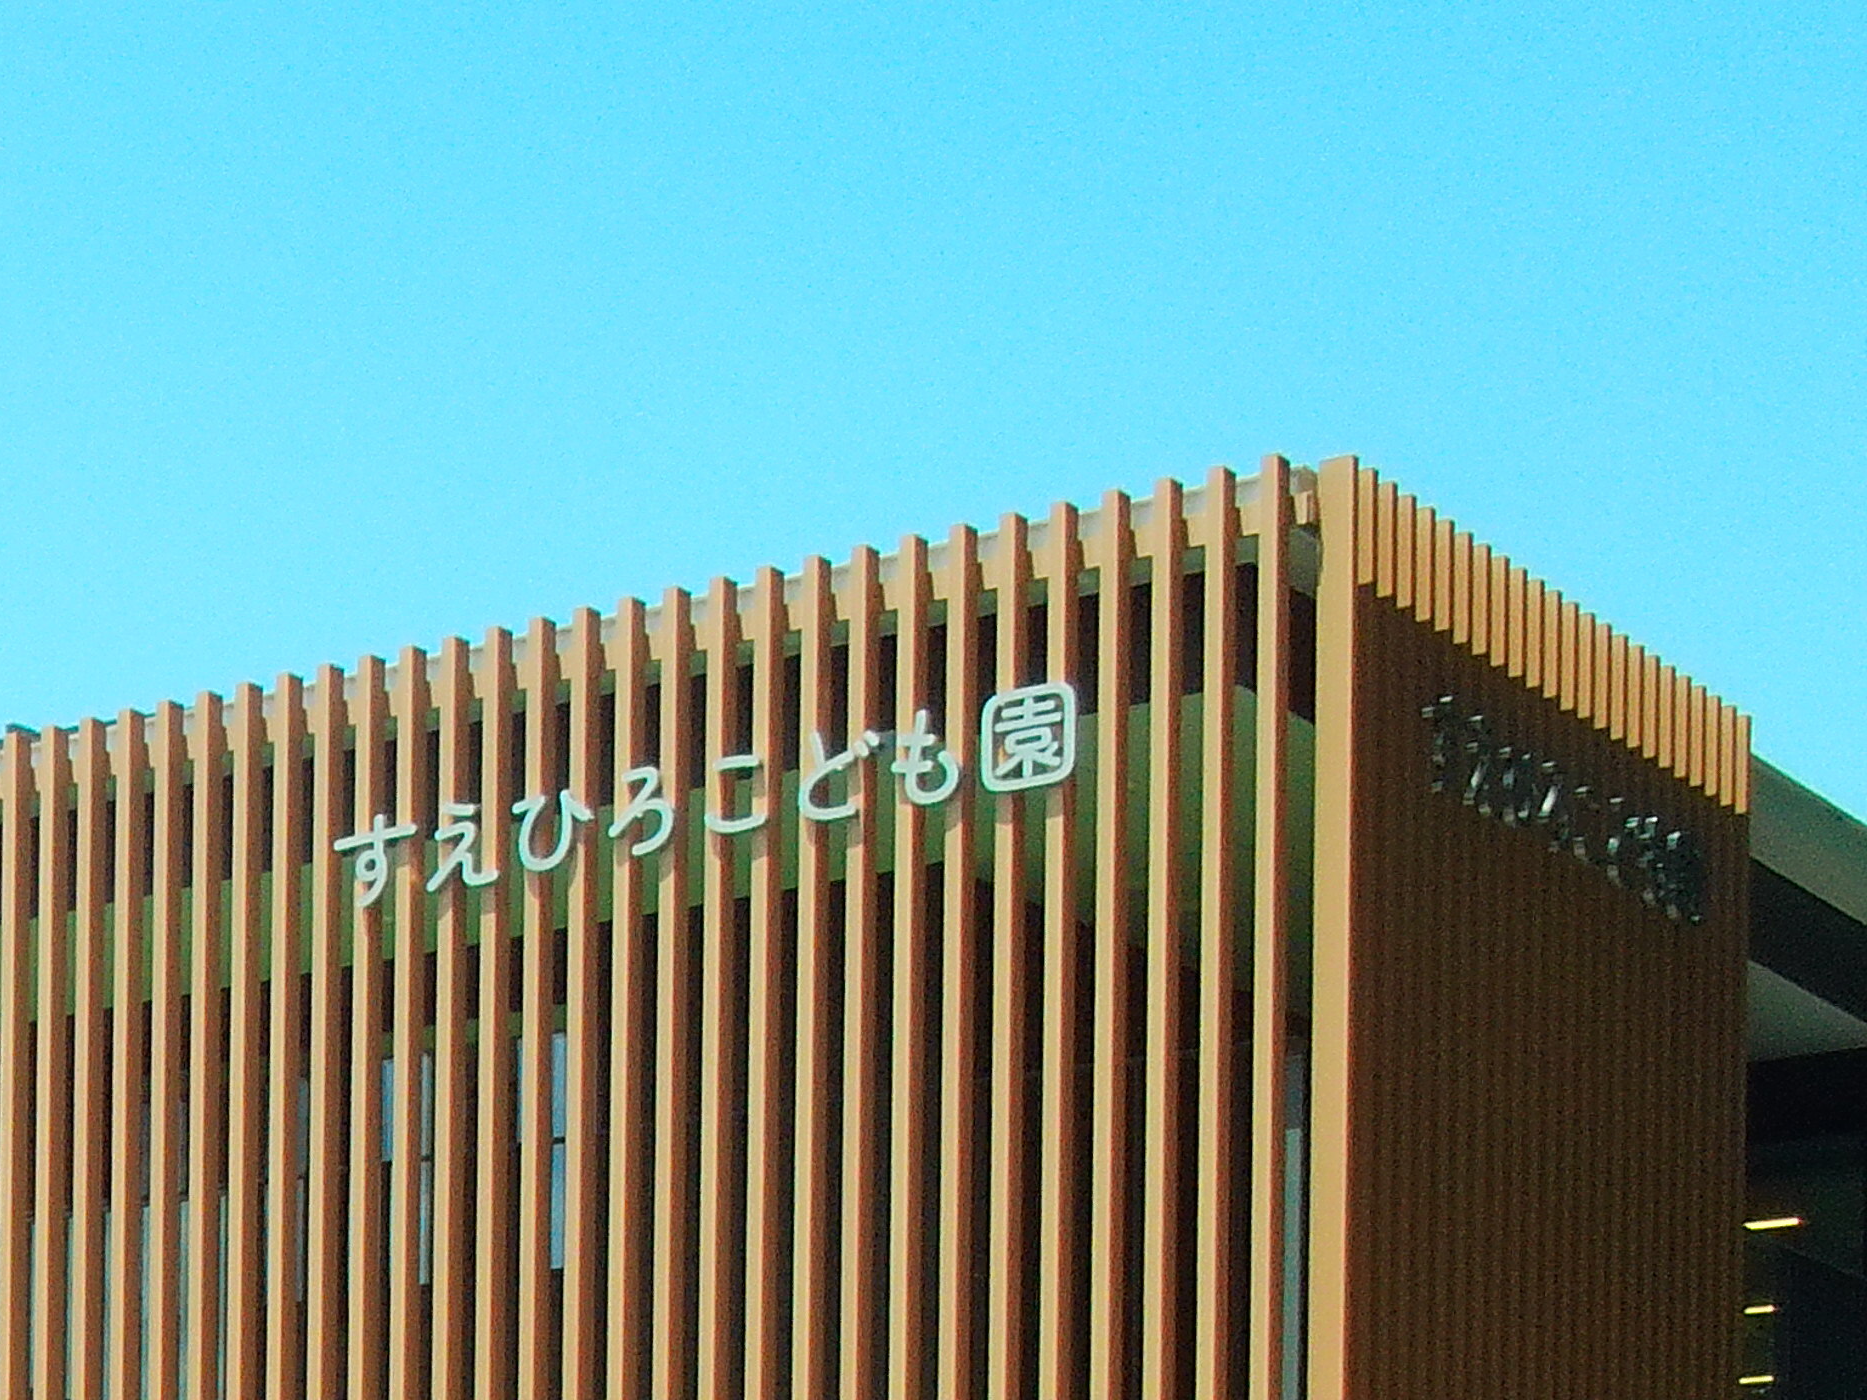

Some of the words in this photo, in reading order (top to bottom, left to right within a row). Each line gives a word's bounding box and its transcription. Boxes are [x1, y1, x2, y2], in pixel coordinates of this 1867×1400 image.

[334, 683, 1076, 907] すえひろこども園
